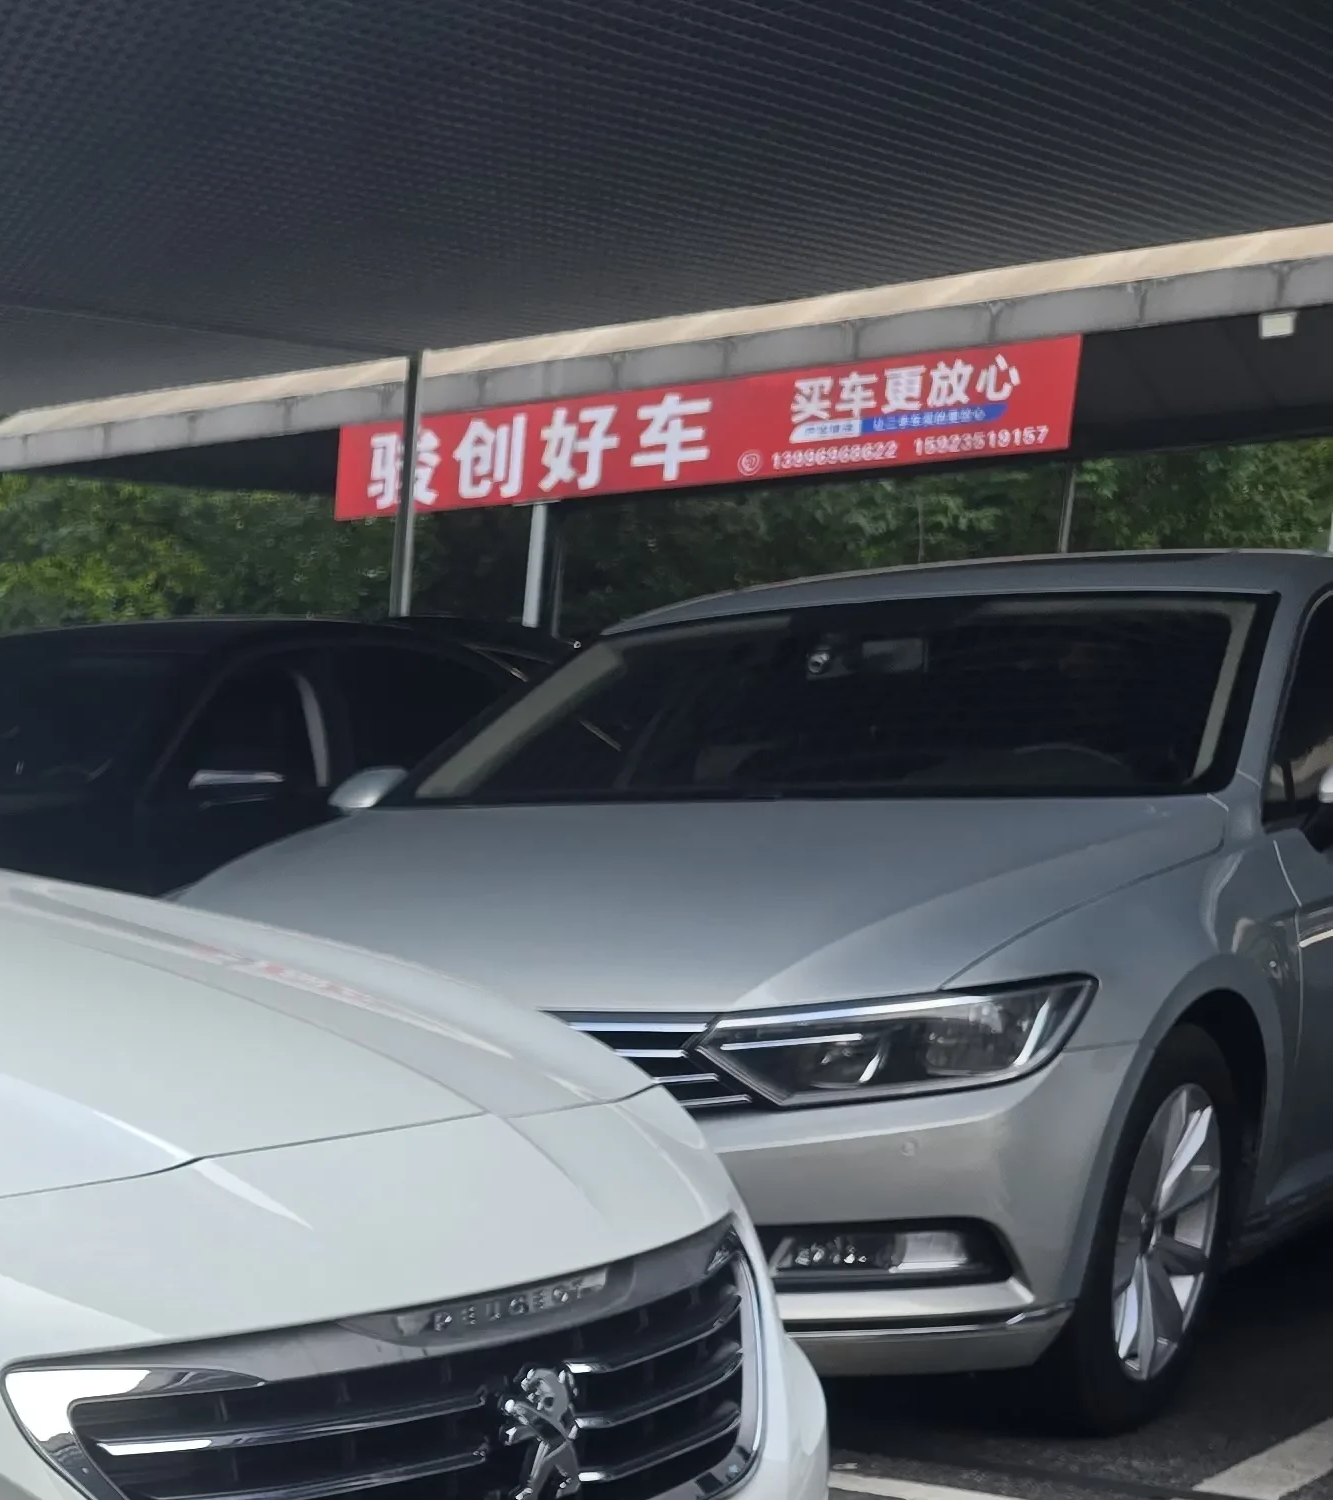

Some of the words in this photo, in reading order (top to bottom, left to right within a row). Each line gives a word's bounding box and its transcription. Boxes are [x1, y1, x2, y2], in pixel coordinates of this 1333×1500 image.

[790, 353, 1021, 425] 买车更放心
[367, 392, 713, 510] 骏创好车
